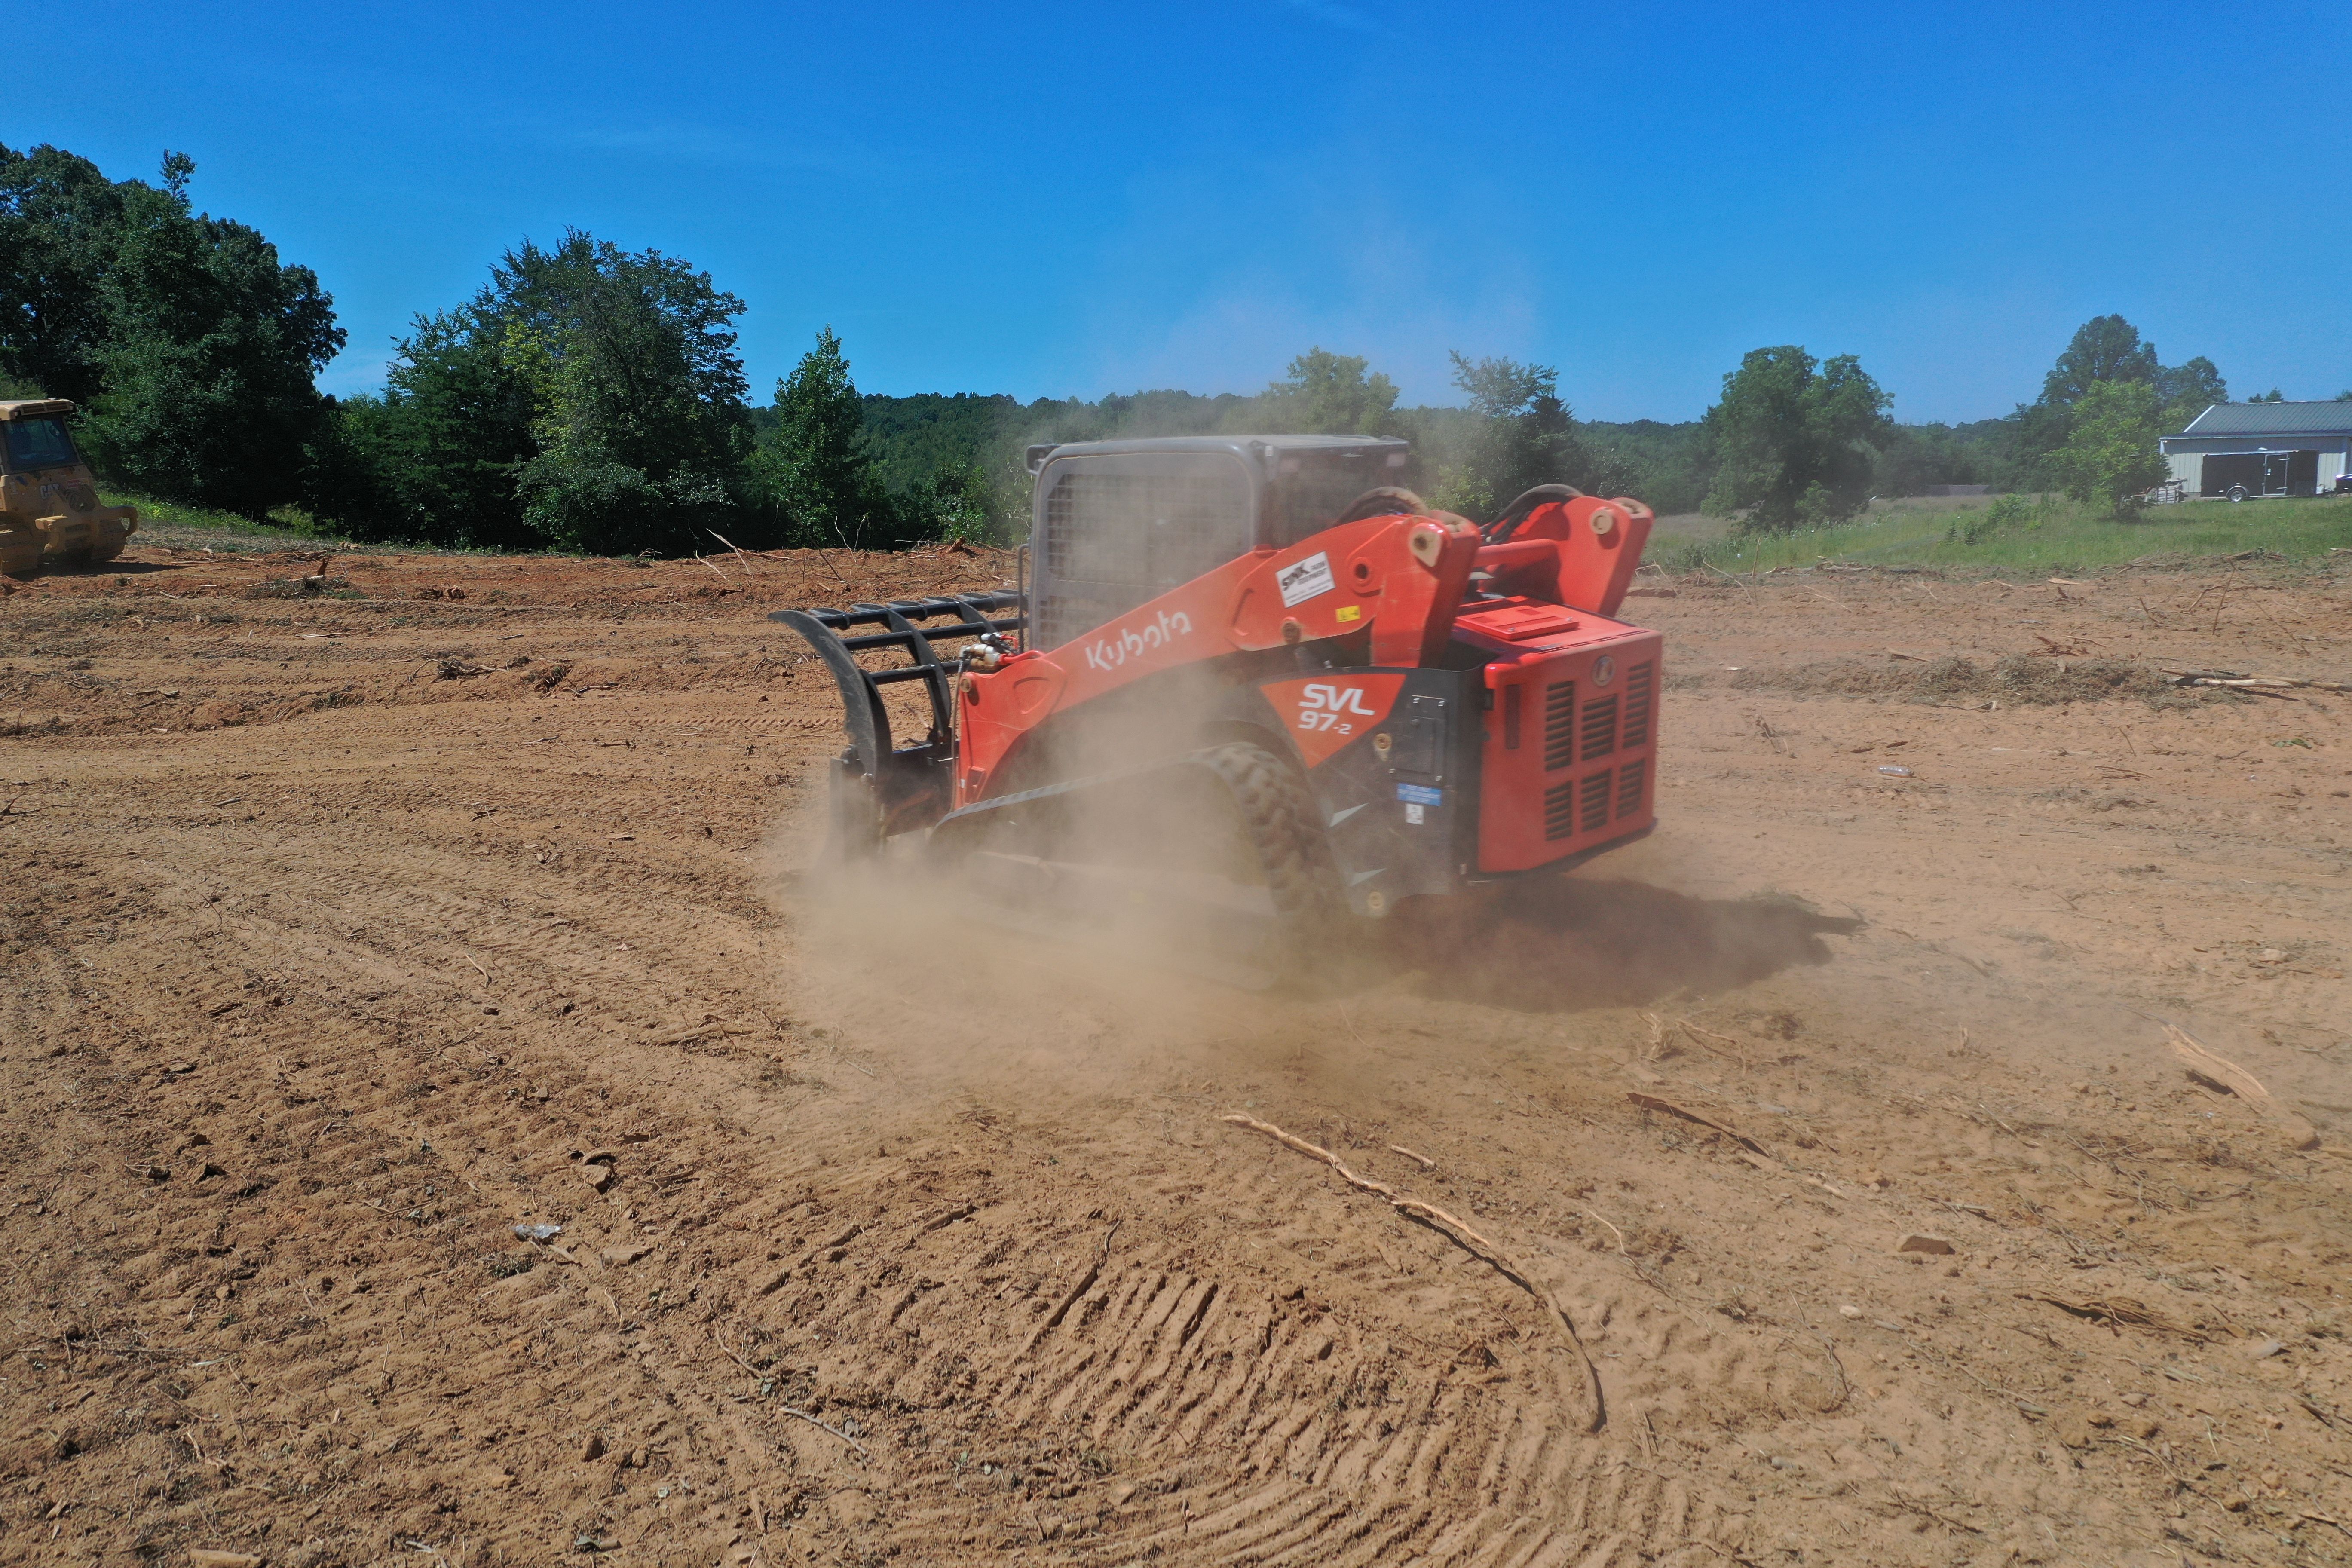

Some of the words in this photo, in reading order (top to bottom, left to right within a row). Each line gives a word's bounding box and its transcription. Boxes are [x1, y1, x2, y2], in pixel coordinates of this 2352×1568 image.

[1084, 610, 1193, 671] Kubota
[1298, 683, 1376, 716] SVL
[1297, 710, 1353, 735] 97-2
